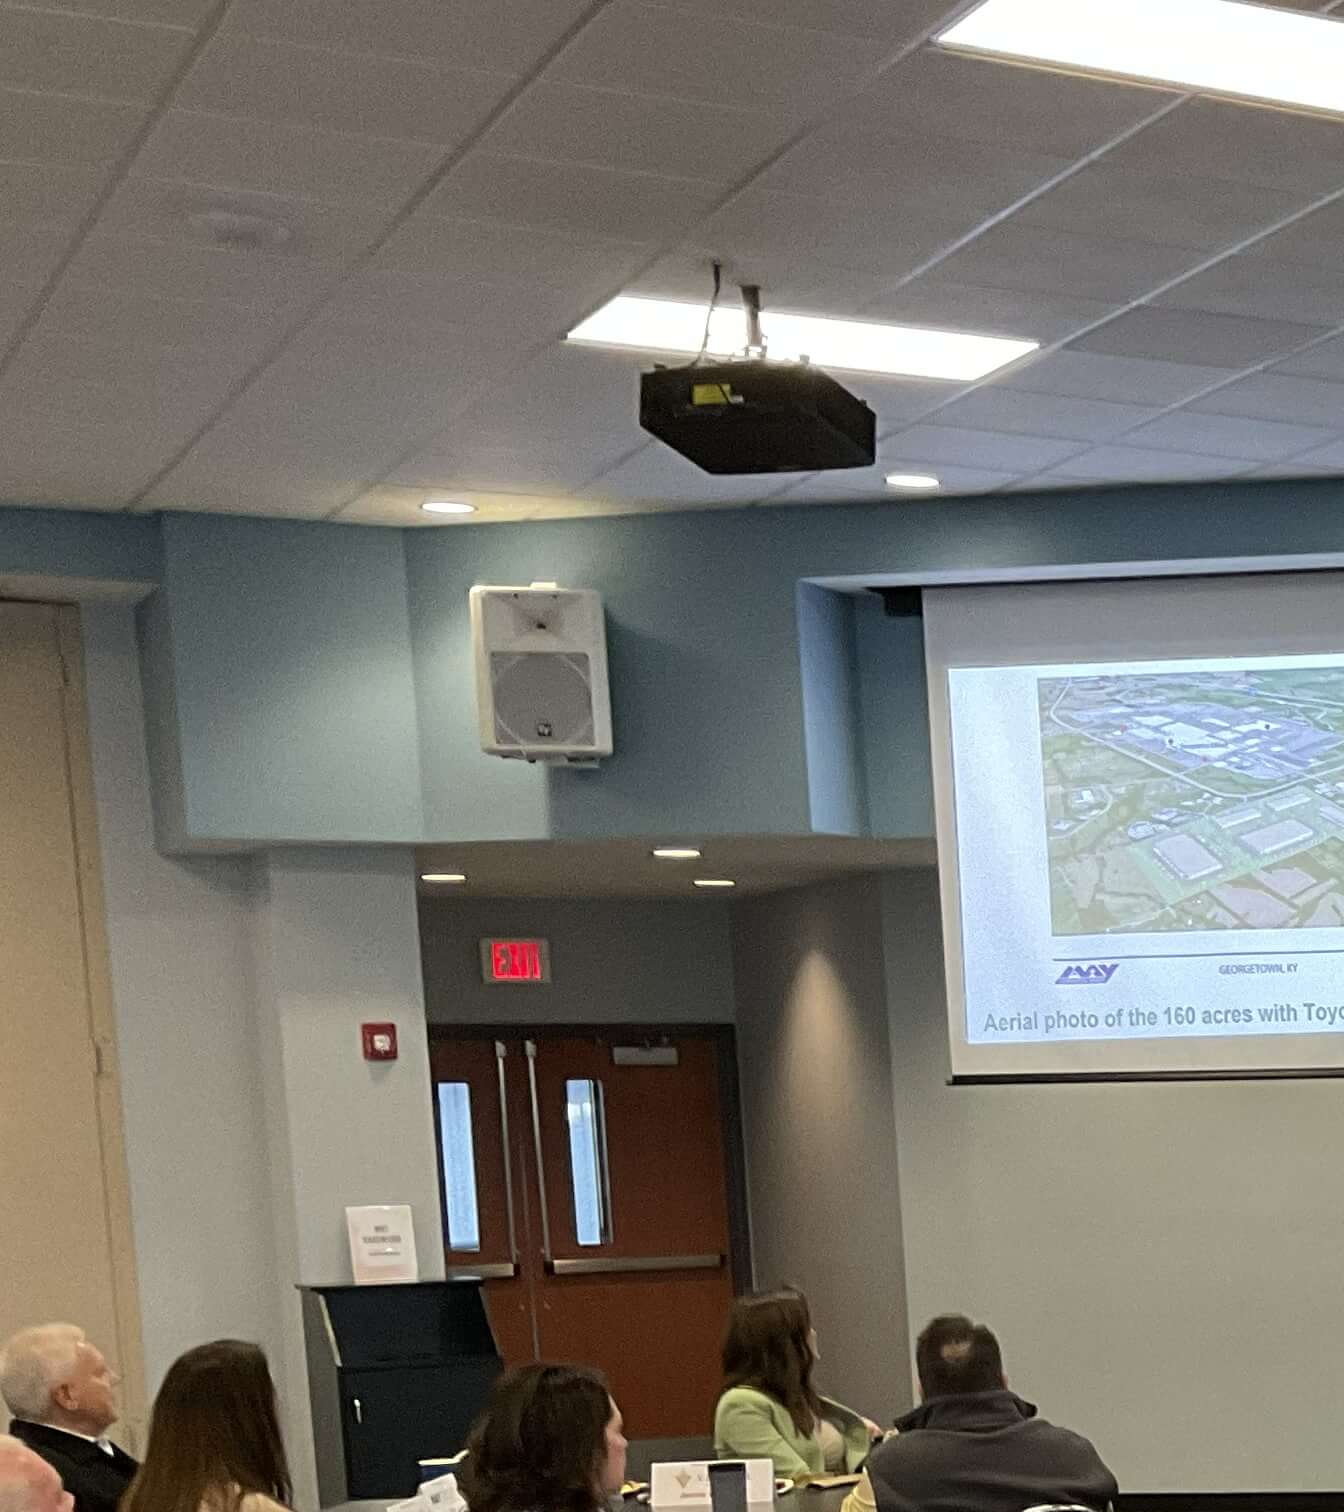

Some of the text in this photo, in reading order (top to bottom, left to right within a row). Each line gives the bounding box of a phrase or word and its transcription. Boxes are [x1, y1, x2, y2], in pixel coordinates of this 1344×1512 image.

[493, 943, 540, 979] EXIT
[984, 1012, 1038, 1032] Aerial
[1044, 1010, 1099, 1033] photo
[1104, 1008, 1123, 1028] of
[1129, 1007, 1158, 1026] the
[1164, 1006, 1196, 1025] 160
[1201, 1006, 1253, 1024] acres
[1257, 1003, 1298, 1022] with
